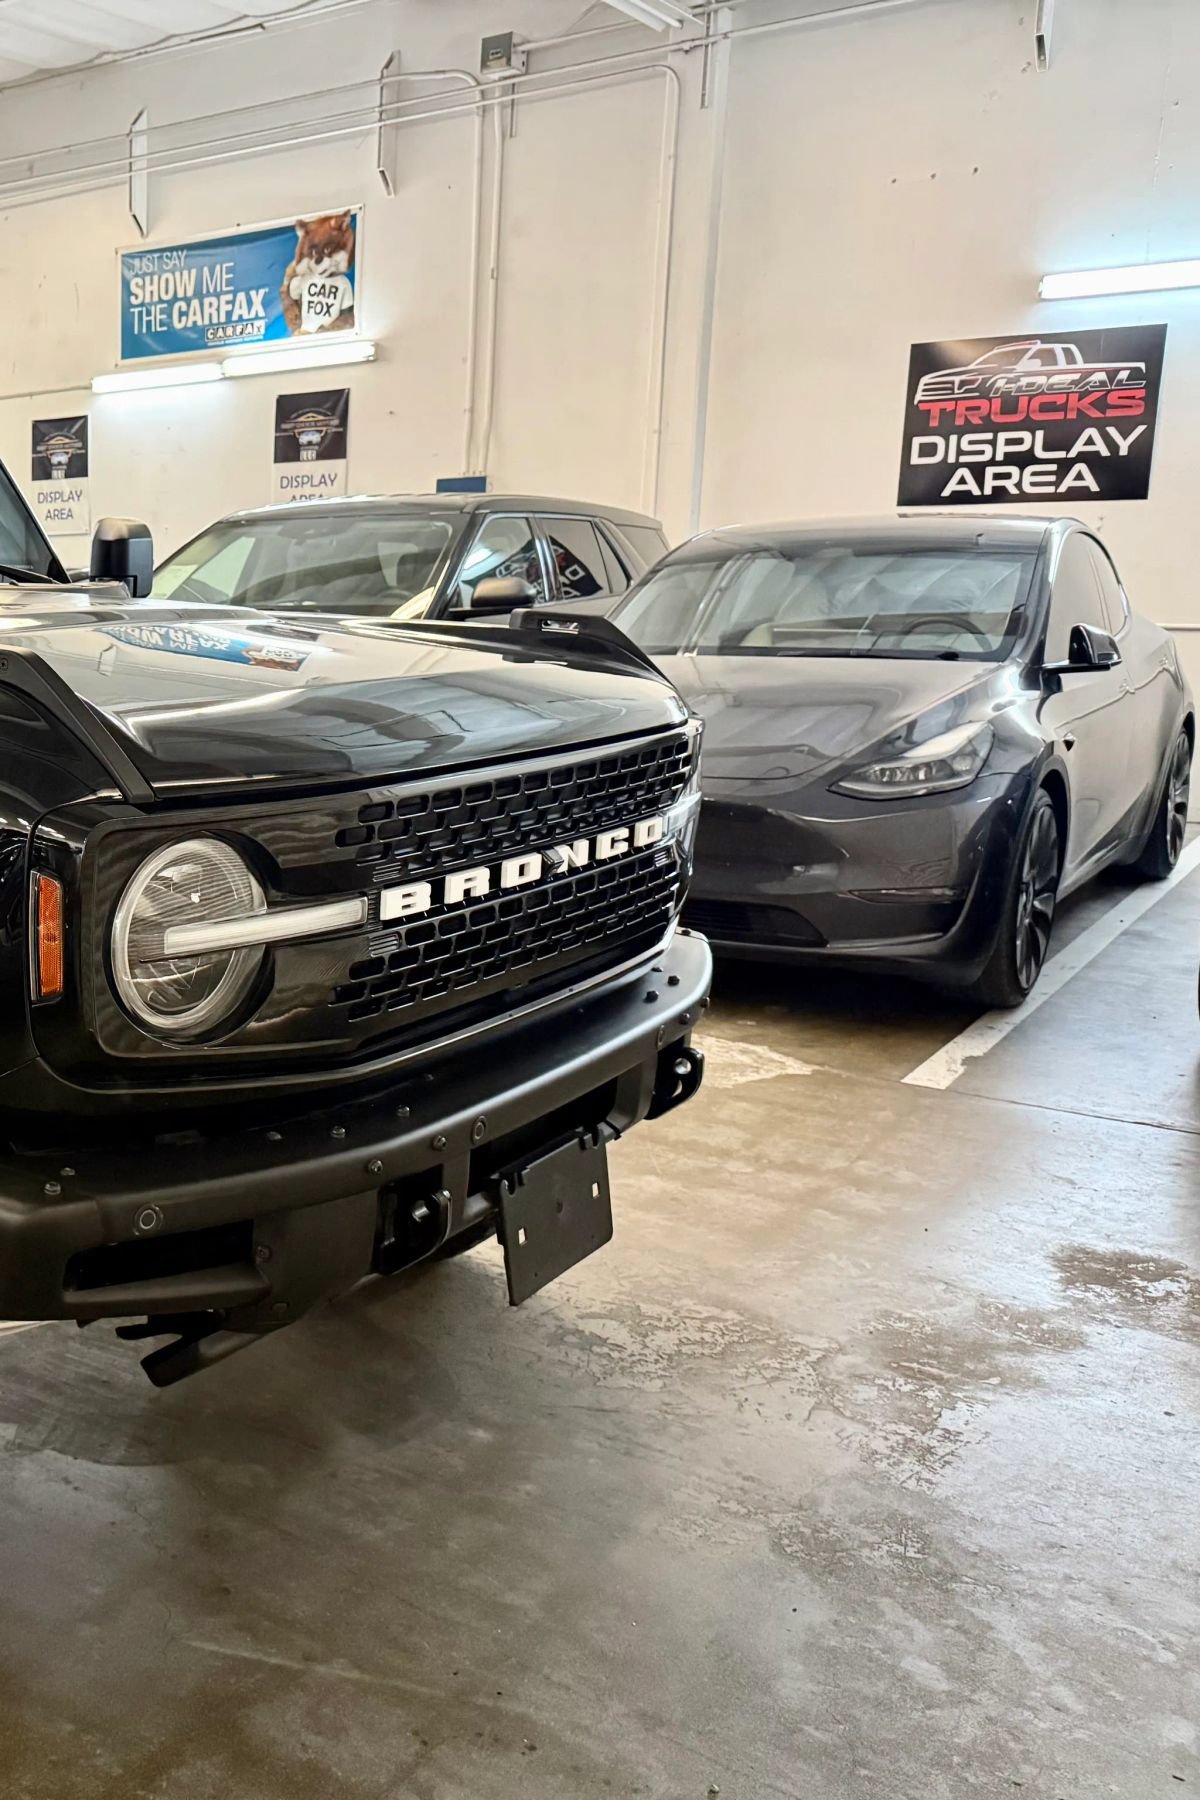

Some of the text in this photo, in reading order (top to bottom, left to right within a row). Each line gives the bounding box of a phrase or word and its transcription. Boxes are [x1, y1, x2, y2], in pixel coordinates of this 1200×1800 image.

[129, 249, 188, 275] JUST SAY
[129, 262, 235, 305] SHOW ME
[307, 282, 339, 300] CAR
[129, 289, 266, 335] THE CARFAX
[307, 300, 335, 317] FOX
[206, 321, 264, 341] CARFAX
[918, 388, 1147, 427] TRUCKS
[910, 424, 1148, 465] DISPLAY
[280, 472, 338, 489] DISPLAY
[940, 462, 1101, 497] AREA
[37, 489, 83, 504] DISPLAY
[45, 508, 74, 521] AREA
[379, 816, 664, 921] BRONCO
